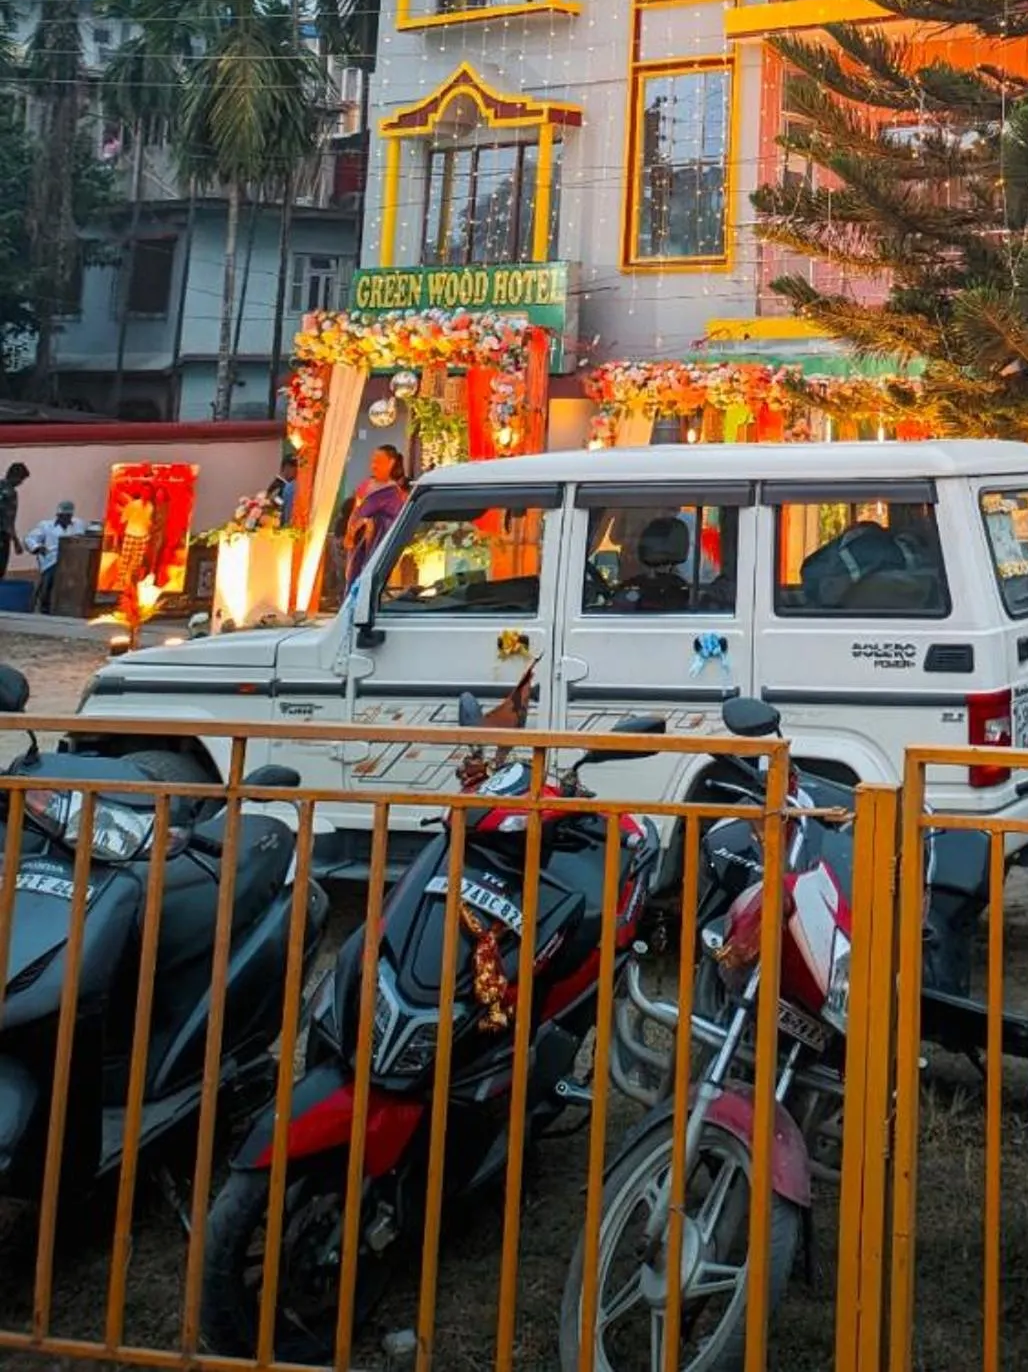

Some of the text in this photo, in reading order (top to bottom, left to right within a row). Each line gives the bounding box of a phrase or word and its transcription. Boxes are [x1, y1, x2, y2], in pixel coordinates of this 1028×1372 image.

[356, 266, 567, 309] GREEN WOOD HOTEL
[851, 642, 917, 659] BOLERO
